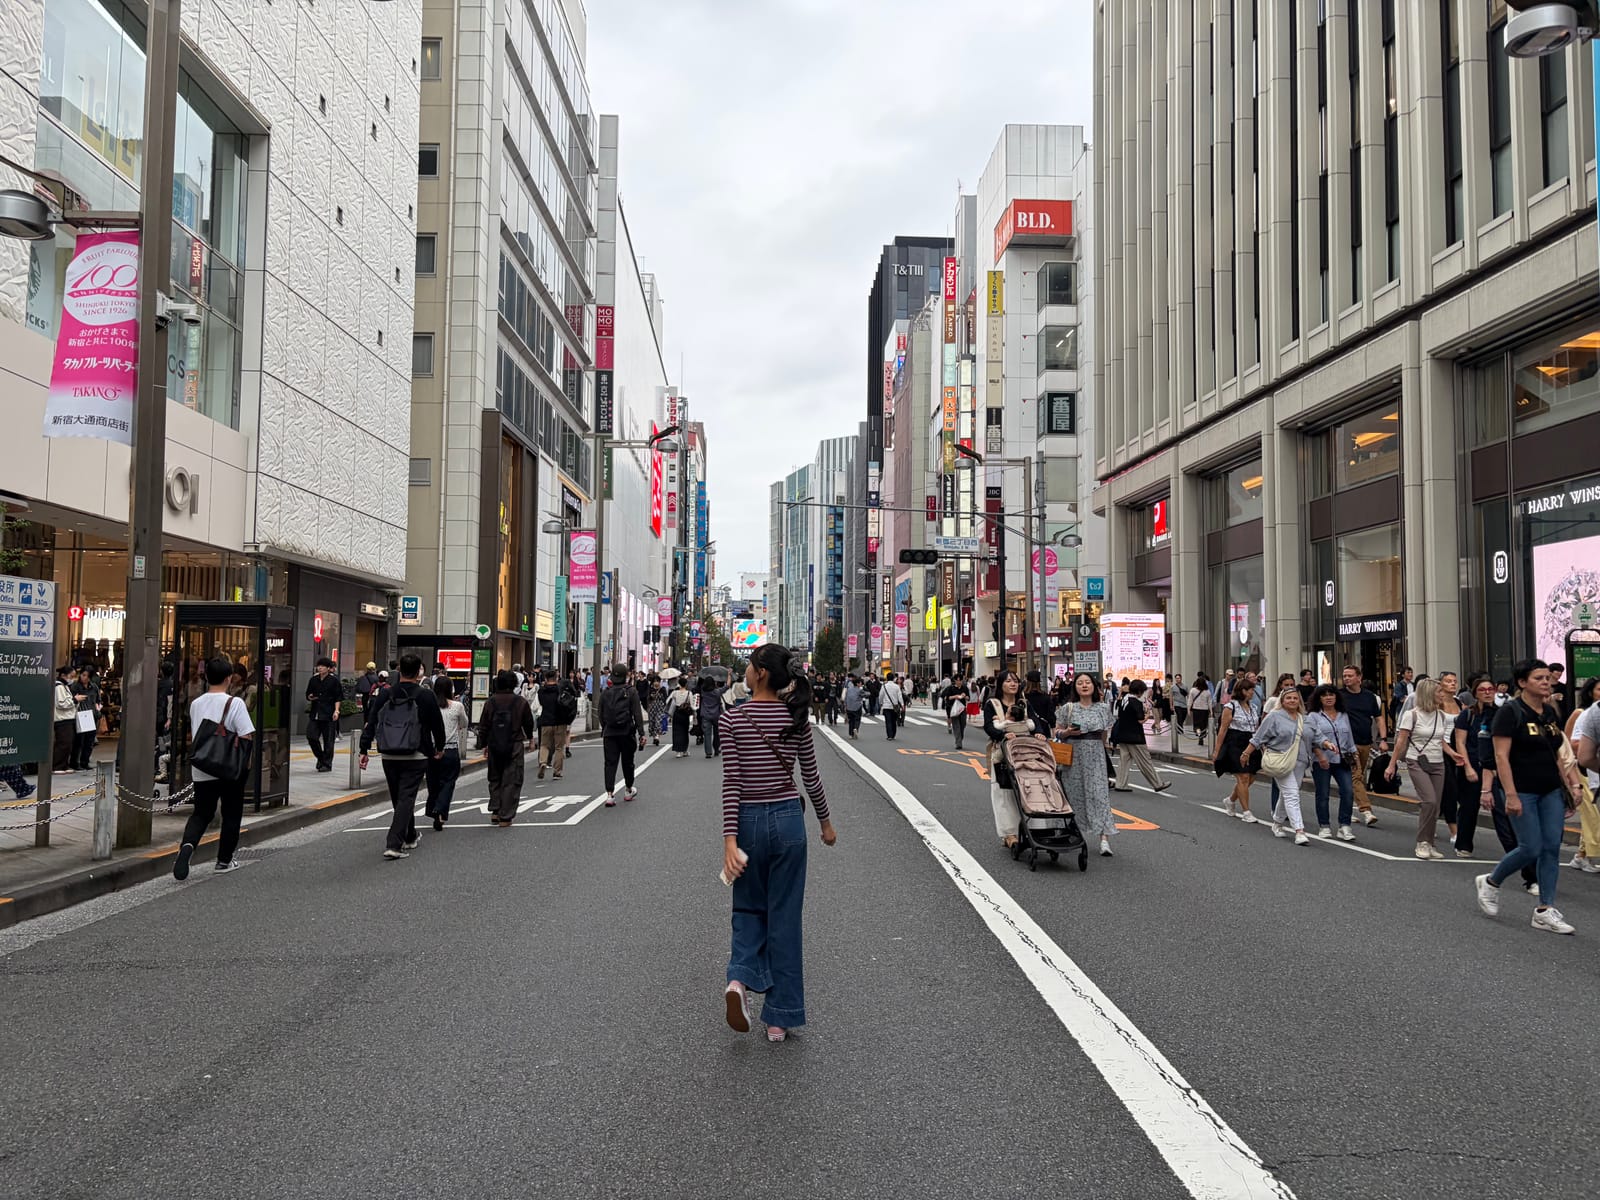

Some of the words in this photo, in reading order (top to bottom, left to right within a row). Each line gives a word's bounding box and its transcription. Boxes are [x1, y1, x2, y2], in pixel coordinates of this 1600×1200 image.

[1017, 211, 1055, 229] BLD.
[70, 262, 138, 288] 100
[946, 261, 955, 297] アカネビル
[83, 308, 107, 316] SINCE
[108, 307, 128, 315] 1926
[79, 328, 129, 338] おかげさまで
[72, 386, 121, 401] TAKANO
[52, 414, 129, 432] 新宿大通商店街
[1528, 493, 1565, 515] HARRY
[1581, 604, 1588, 613] 3
[1339, 623, 1362, 636] HARRY
[1364, 619, 1398, 633] WINSTON
[10, 666, 21, 676] City
[23, 667, 36, 675] Area
[37, 666, 50, 677] Map
[20, 712, 30, 721] City
